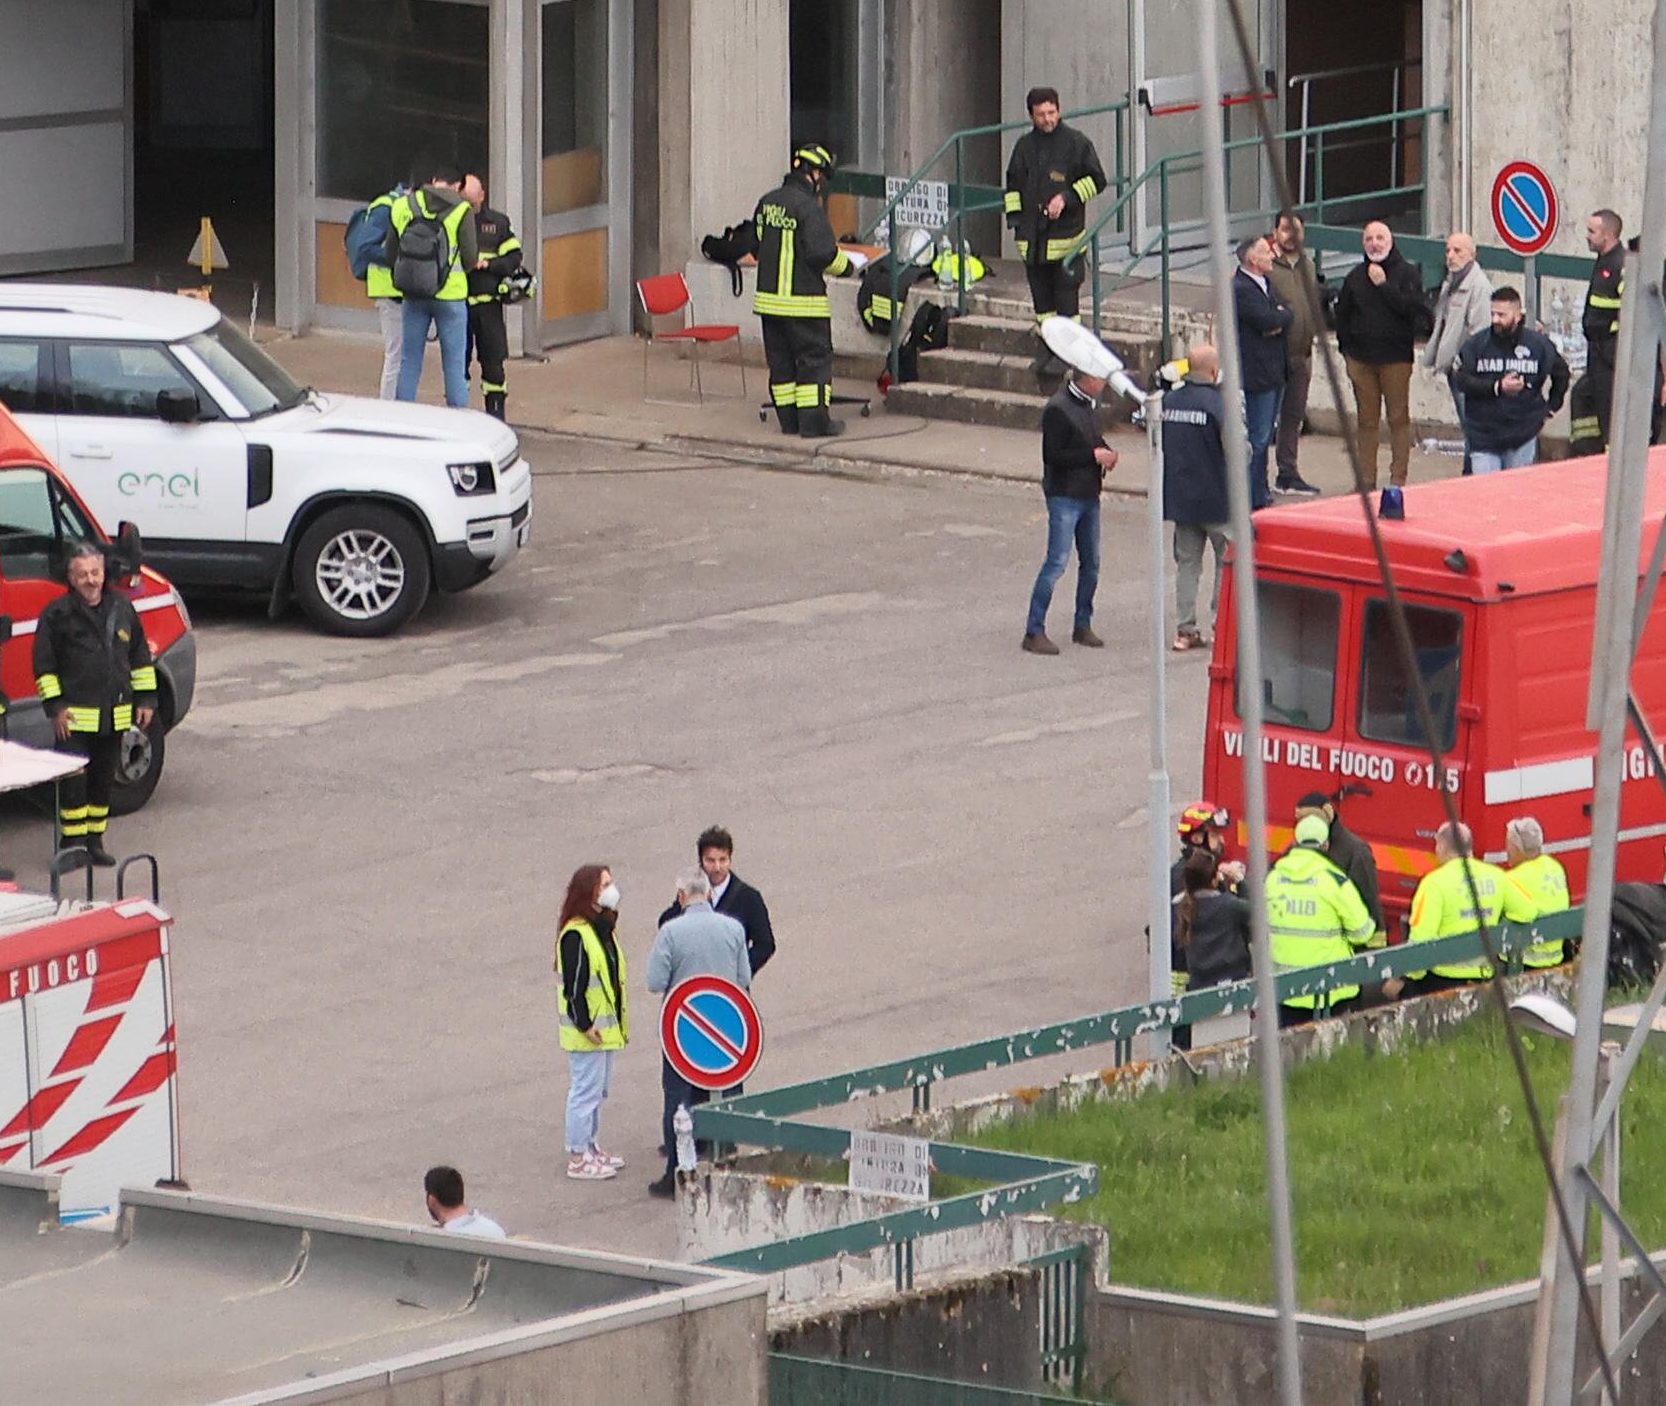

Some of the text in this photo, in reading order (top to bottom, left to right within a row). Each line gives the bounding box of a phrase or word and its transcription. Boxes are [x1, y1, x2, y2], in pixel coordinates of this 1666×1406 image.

[895, 209, 946, 227] ICUREZZA
[1476, 357, 1539, 374] ARABINIERI
[117, 465, 199, 498] enel
[1286, 741, 1323, 771] DEL
[1329, 748, 1395, 784] FUOCO
[1425, 766, 1461, 794] 15
[9, 947, 100, 998] FUOCO
